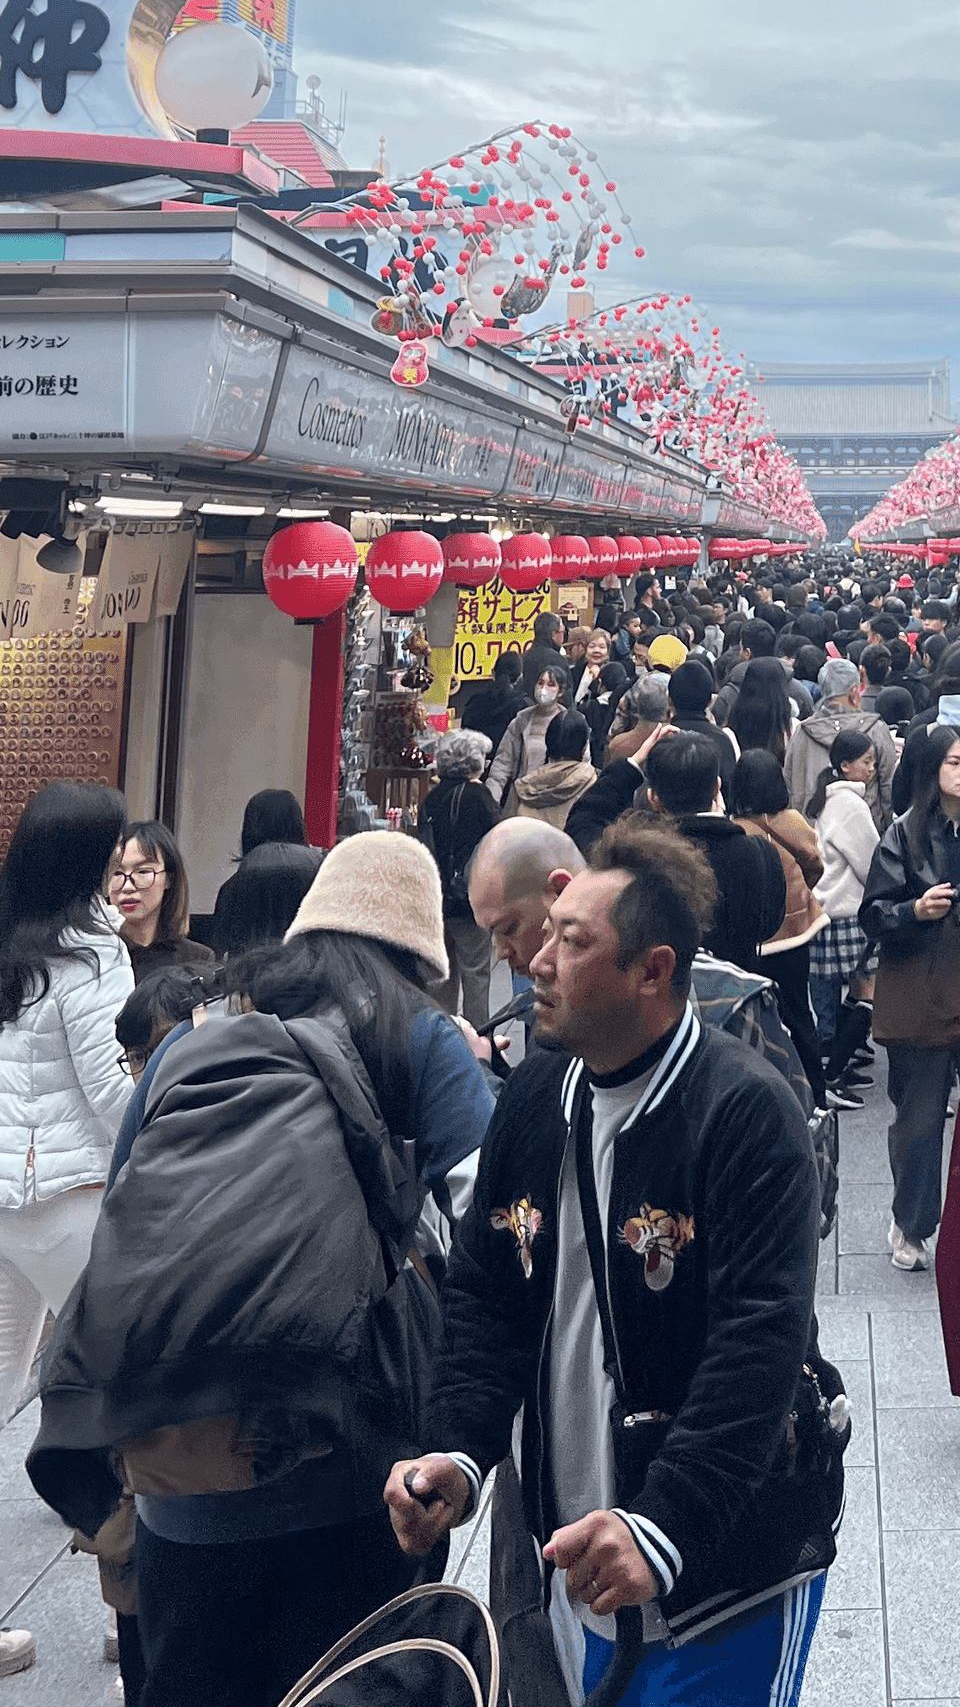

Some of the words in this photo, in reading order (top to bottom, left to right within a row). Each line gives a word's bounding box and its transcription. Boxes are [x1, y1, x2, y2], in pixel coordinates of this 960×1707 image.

[0, 335, 71, 350] レクション
[298, 377, 367, 448] Cosmetics
